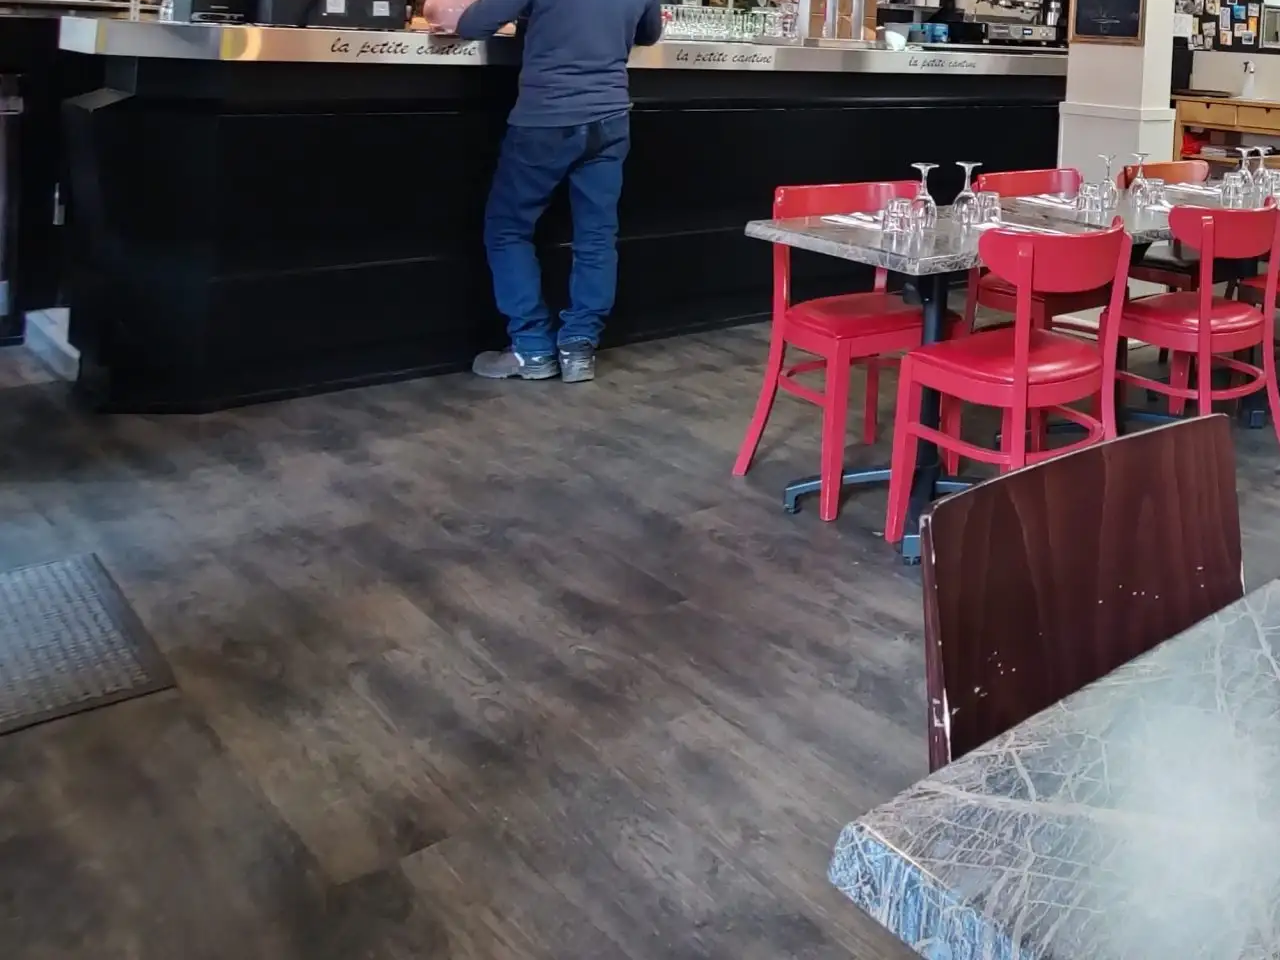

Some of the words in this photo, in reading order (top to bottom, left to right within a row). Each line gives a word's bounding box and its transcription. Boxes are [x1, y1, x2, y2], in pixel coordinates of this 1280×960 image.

[330, 37, 350, 53] la
[357, 40, 411, 57] petite
[416, 42, 478, 56] cantine
[676, 48, 689, 61] la
[693, 51, 728, 65] petite
[732, 52, 772, 64] cantine
[908, 55, 919, 67] la
